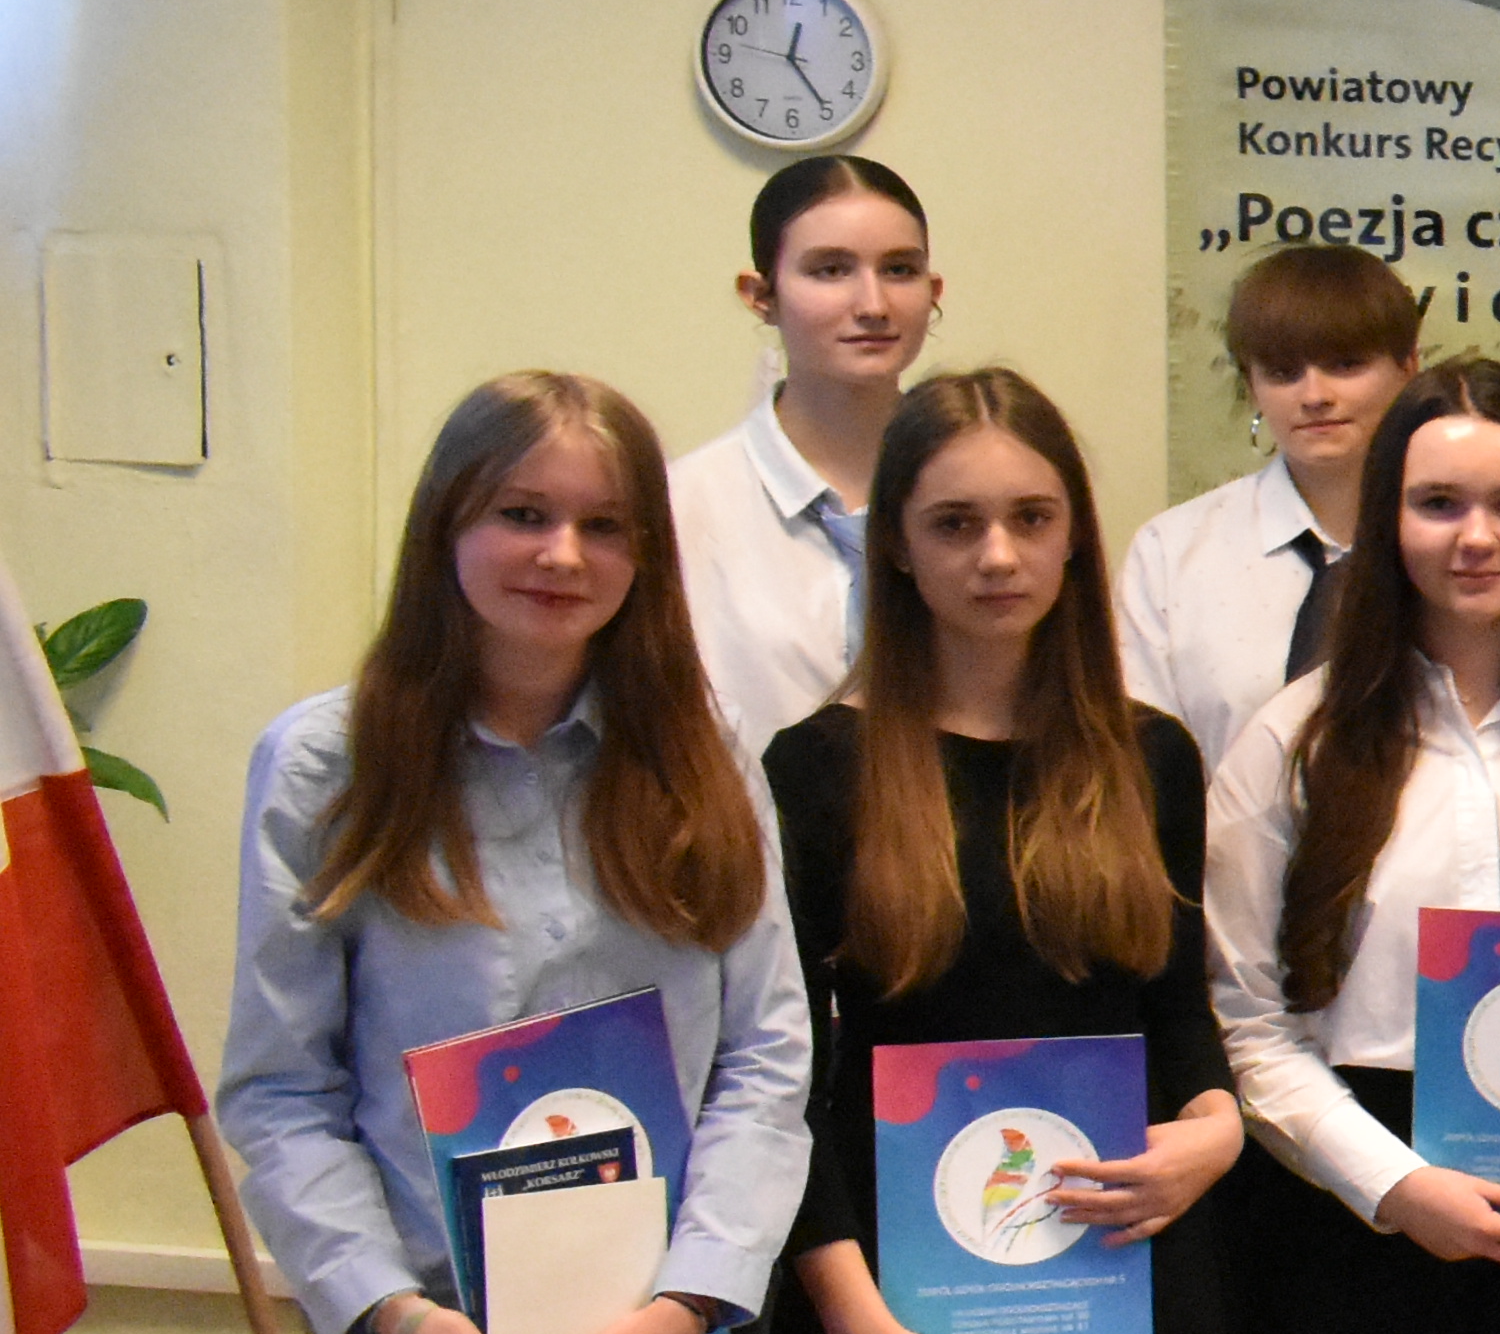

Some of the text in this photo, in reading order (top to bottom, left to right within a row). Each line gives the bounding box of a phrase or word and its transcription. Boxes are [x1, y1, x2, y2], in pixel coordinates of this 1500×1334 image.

[1236, 66, 1474, 117] Powiatowy
[1238, 121, 1412, 159] Konkurs
[1456, 271, 1470, 323] i
